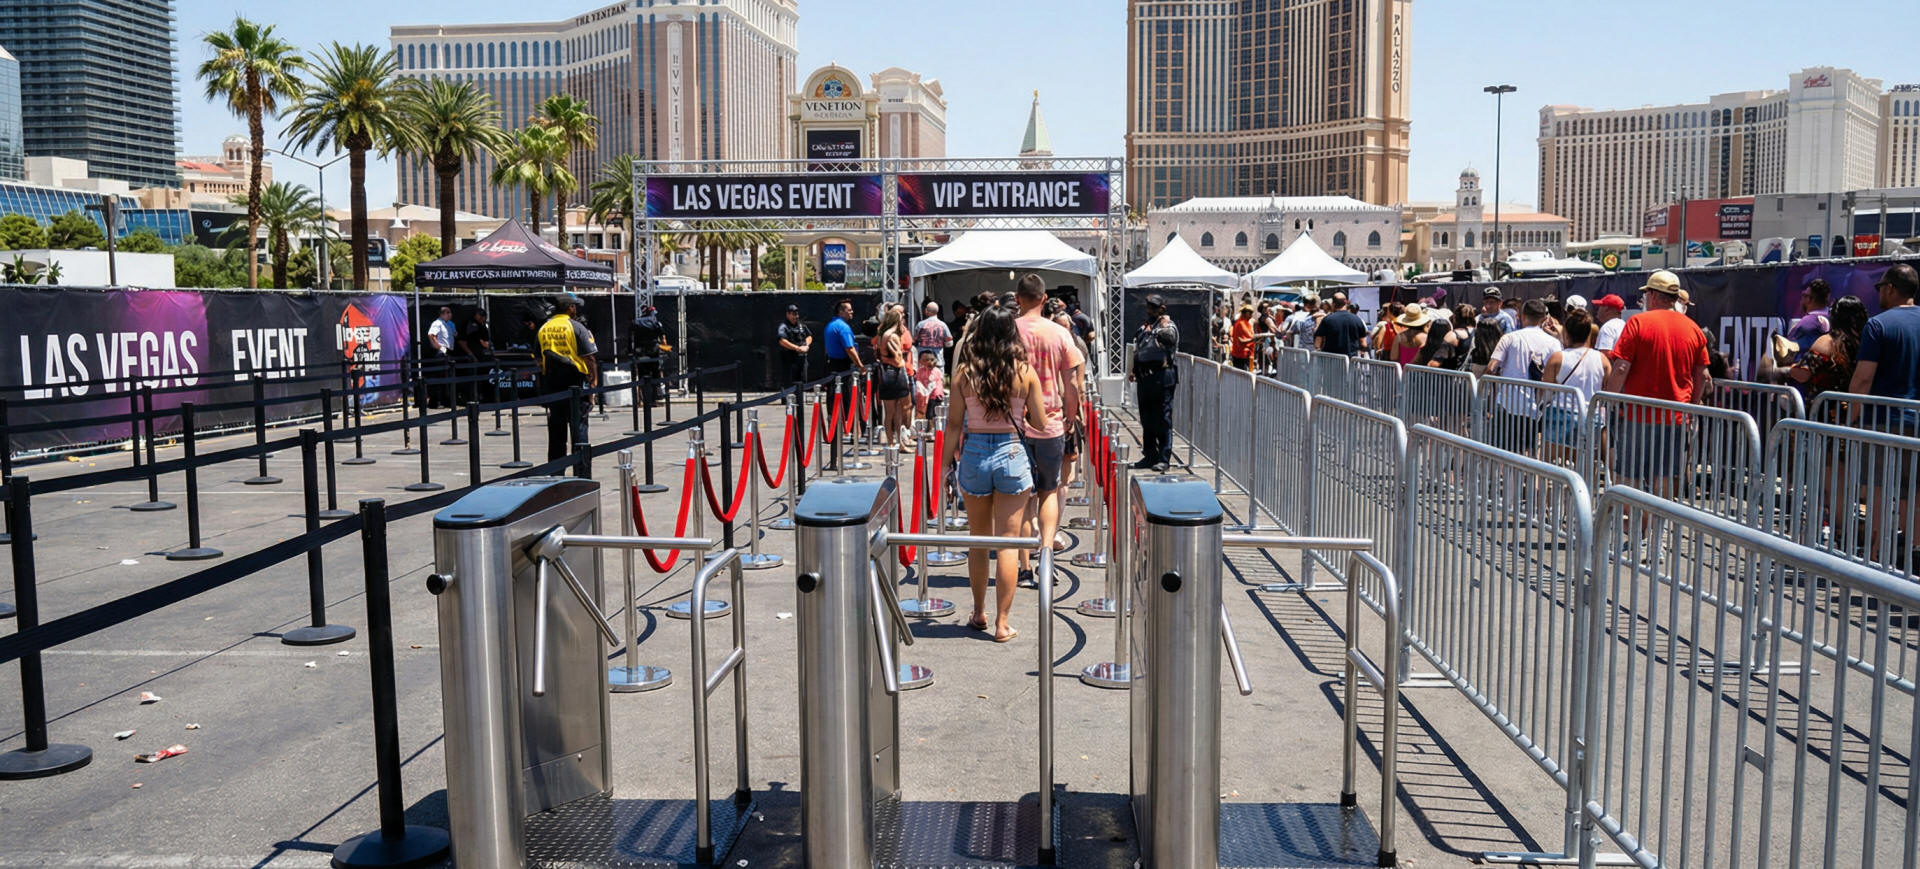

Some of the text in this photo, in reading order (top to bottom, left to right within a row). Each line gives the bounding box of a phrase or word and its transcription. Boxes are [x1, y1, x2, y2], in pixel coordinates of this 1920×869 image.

[673, 183, 855, 210] LAS VEGAS EVENT
[932, 181, 1080, 208] VIP ENTRANCE
[20, 331, 199, 400] LAS VEGAS
[232, 328, 307, 381] EVENT
